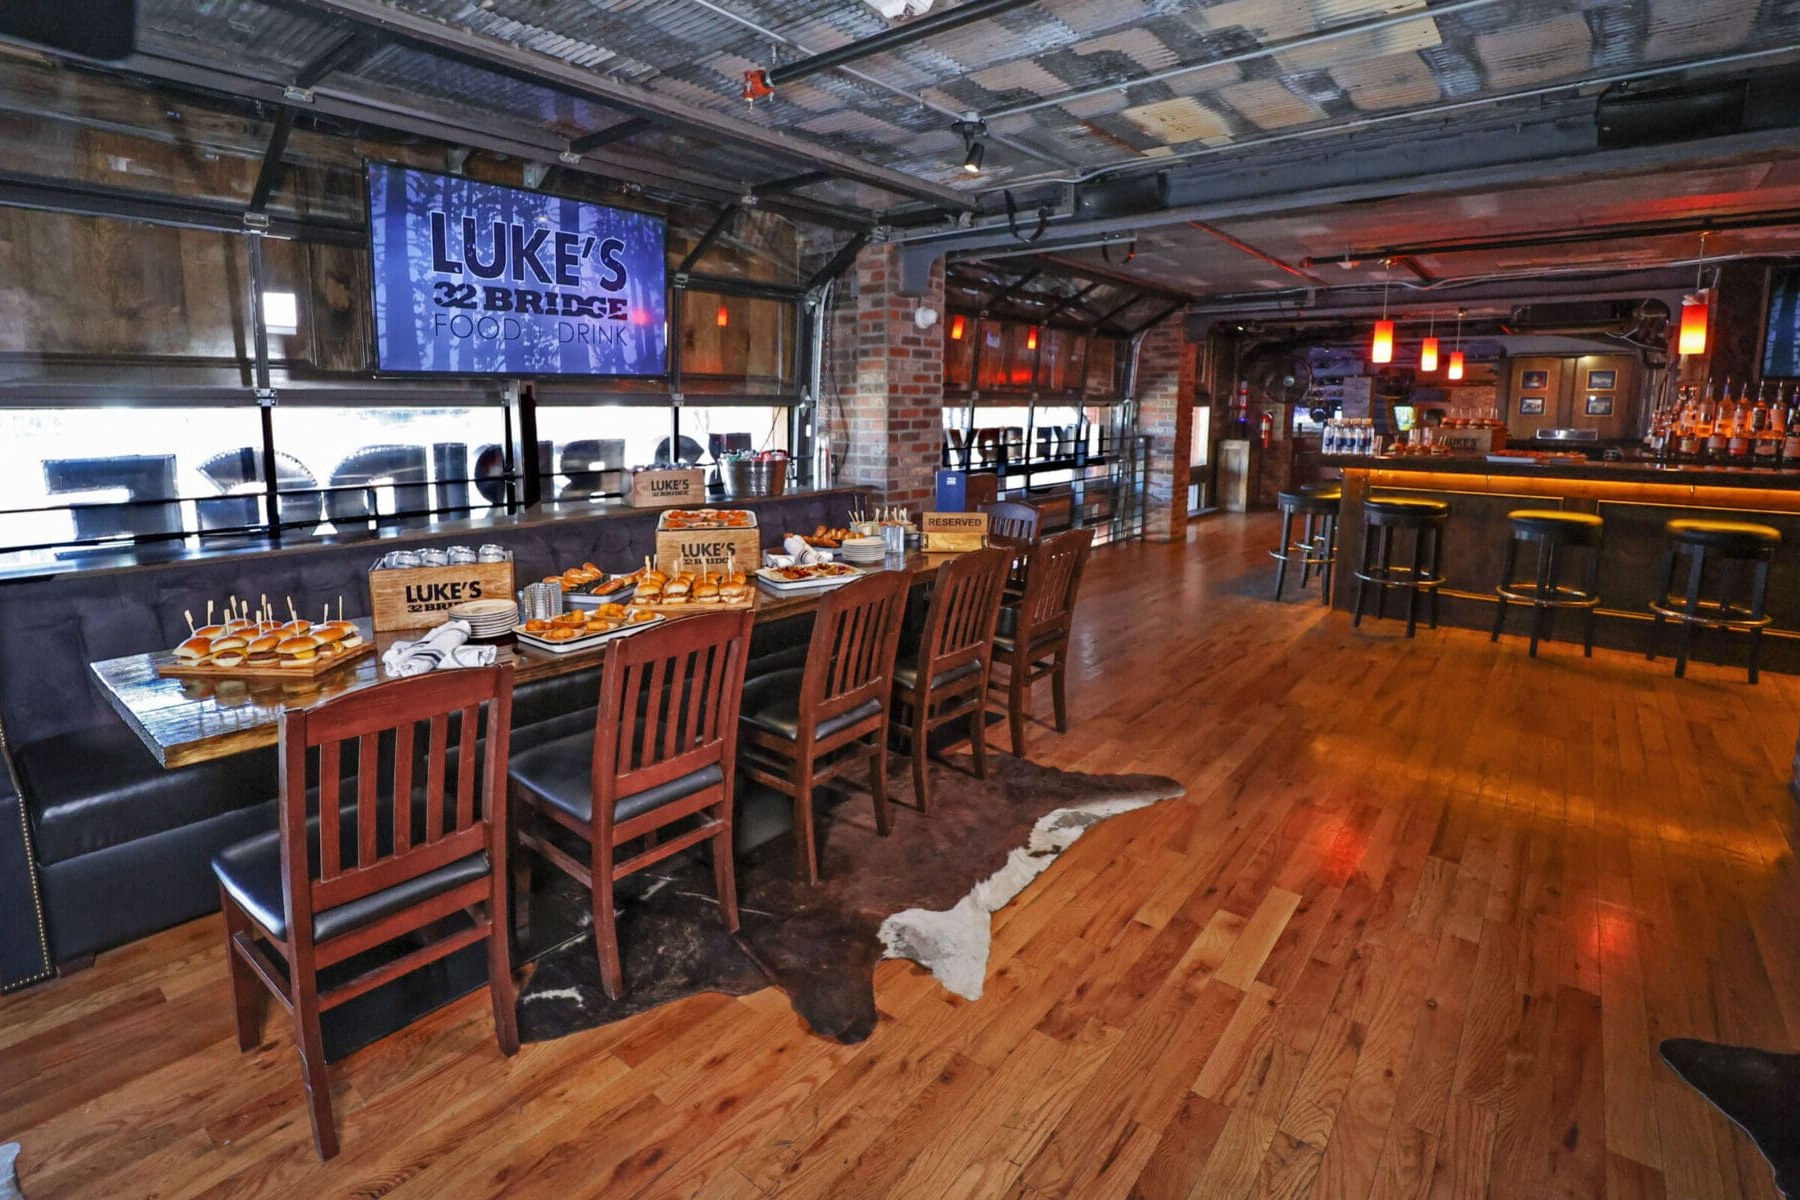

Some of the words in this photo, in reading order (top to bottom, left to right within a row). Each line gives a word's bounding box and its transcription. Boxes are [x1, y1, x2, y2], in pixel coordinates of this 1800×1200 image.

[430, 211, 628, 292] LUKE'S
[433, 281, 477, 309] 32
[483, 286, 628, 321] BRIDGE
[434, 314, 521, 341] FOOD
[558, 322, 627, 346] DRINK
[650, 479, 689, 491] LUKE'S
[928, 518, 982, 527] RESERVED
[681, 542, 736, 557] LUKE'S
[405, 580, 482, 603] LUKE'S
[407, 604, 422, 613] 32
